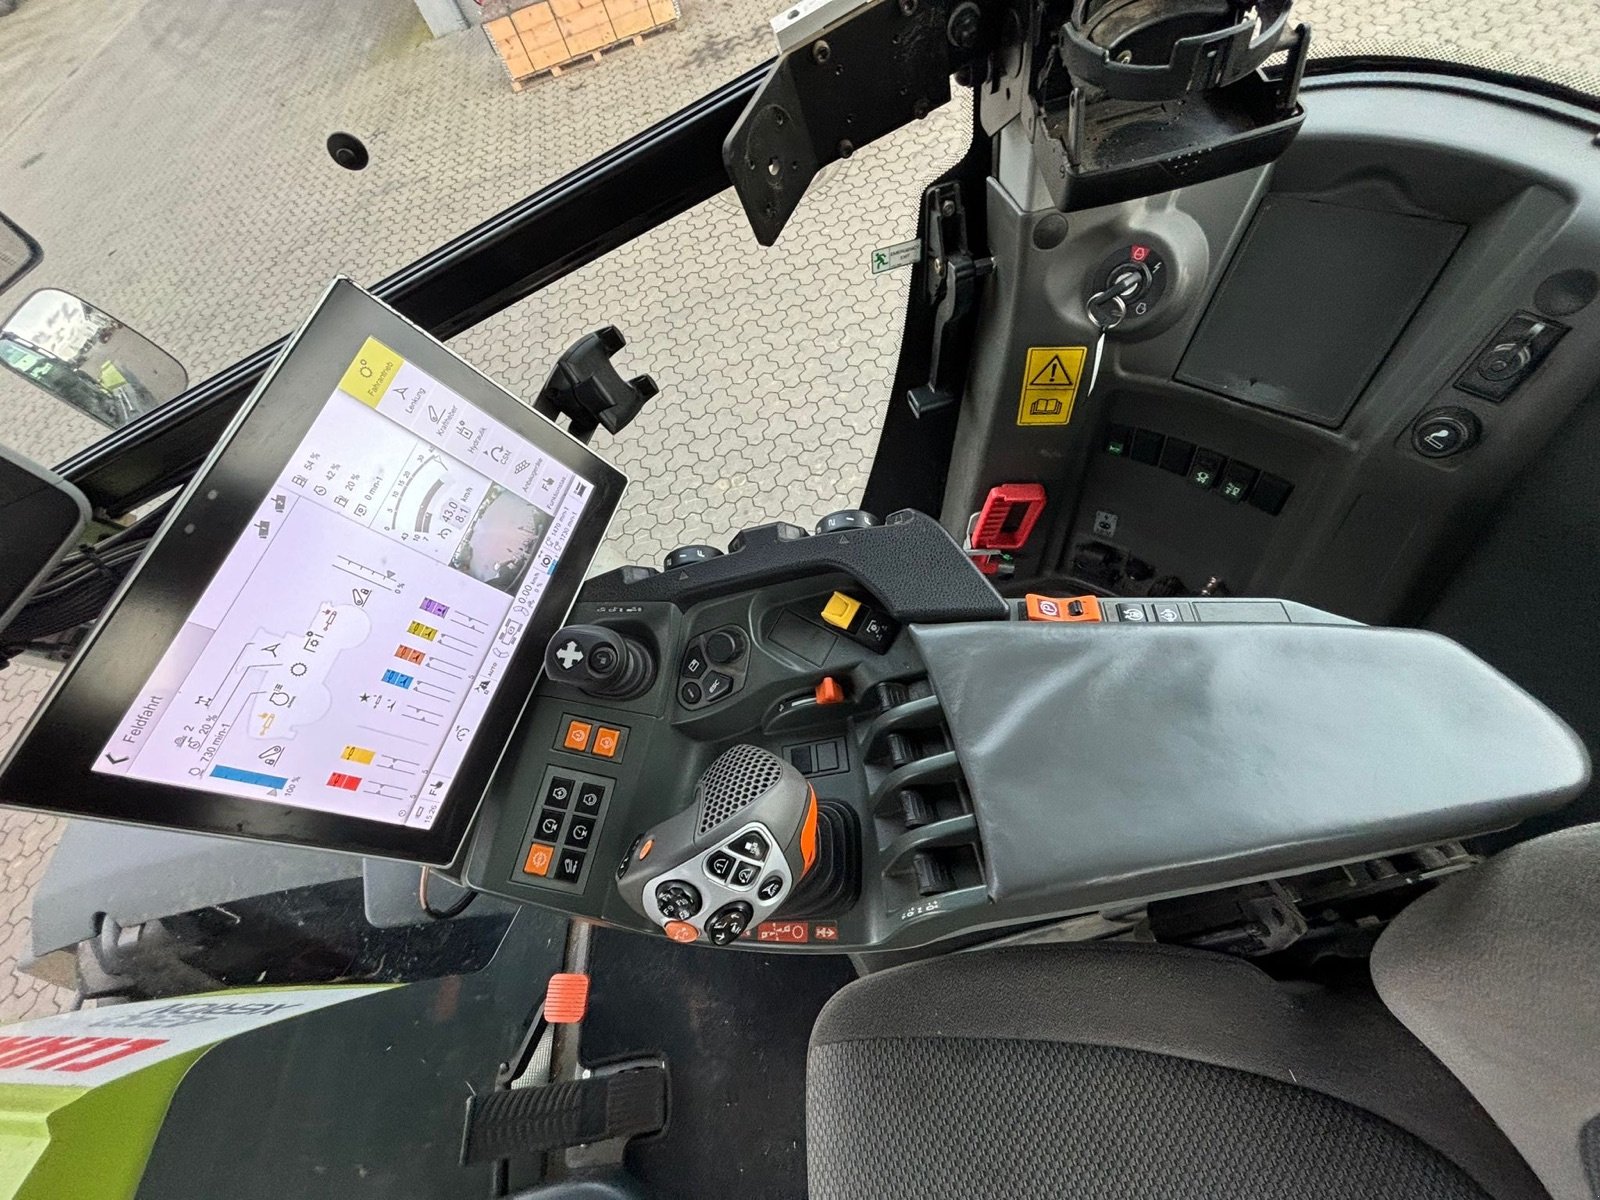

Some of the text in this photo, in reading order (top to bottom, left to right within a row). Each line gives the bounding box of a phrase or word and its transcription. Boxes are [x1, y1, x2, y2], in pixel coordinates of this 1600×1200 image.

[367, 359, 394, 396] Fahrantrieb
[405, 386, 426, 415] Lenkung
[435, 404, 458, 437] Kraftheber
[467, 425, 487, 454] Hydraulik
[303, 451, 321, 471] 54 %
[416, 453, 424, 462] 30
[499, 448, 512, 465] CSM
[324, 462, 341, 481] 42 %
[402, 470, 411, 478] 20
[520, 455, 544, 493] Anbaugeräte
[344, 472, 361, 491] 20 %
[397, 479, 405, 487] 15
[391, 490, 399, 498] 10
[440, 485, 473, 523] 43.0 km/h
[454, 507, 469, 523] 8.1
[399, 531, 409, 541] 43
[412, 533, 420, 542] 10
[550, 522, 560, 536] 1470
[559, 527, 569, 541] 1730
[397, 581, 405, 589] %
[517, 583, 533, 604] 0.00
[487, 662, 497, 676] AUTO
[121, 694, 163, 743] Feldfahrt
[197, 713, 218, 735] 20 %
[199, 722, 230, 762] 730 min-1
[283, 783, 297, 796] 100
[663, 905, 674, 916] F9
